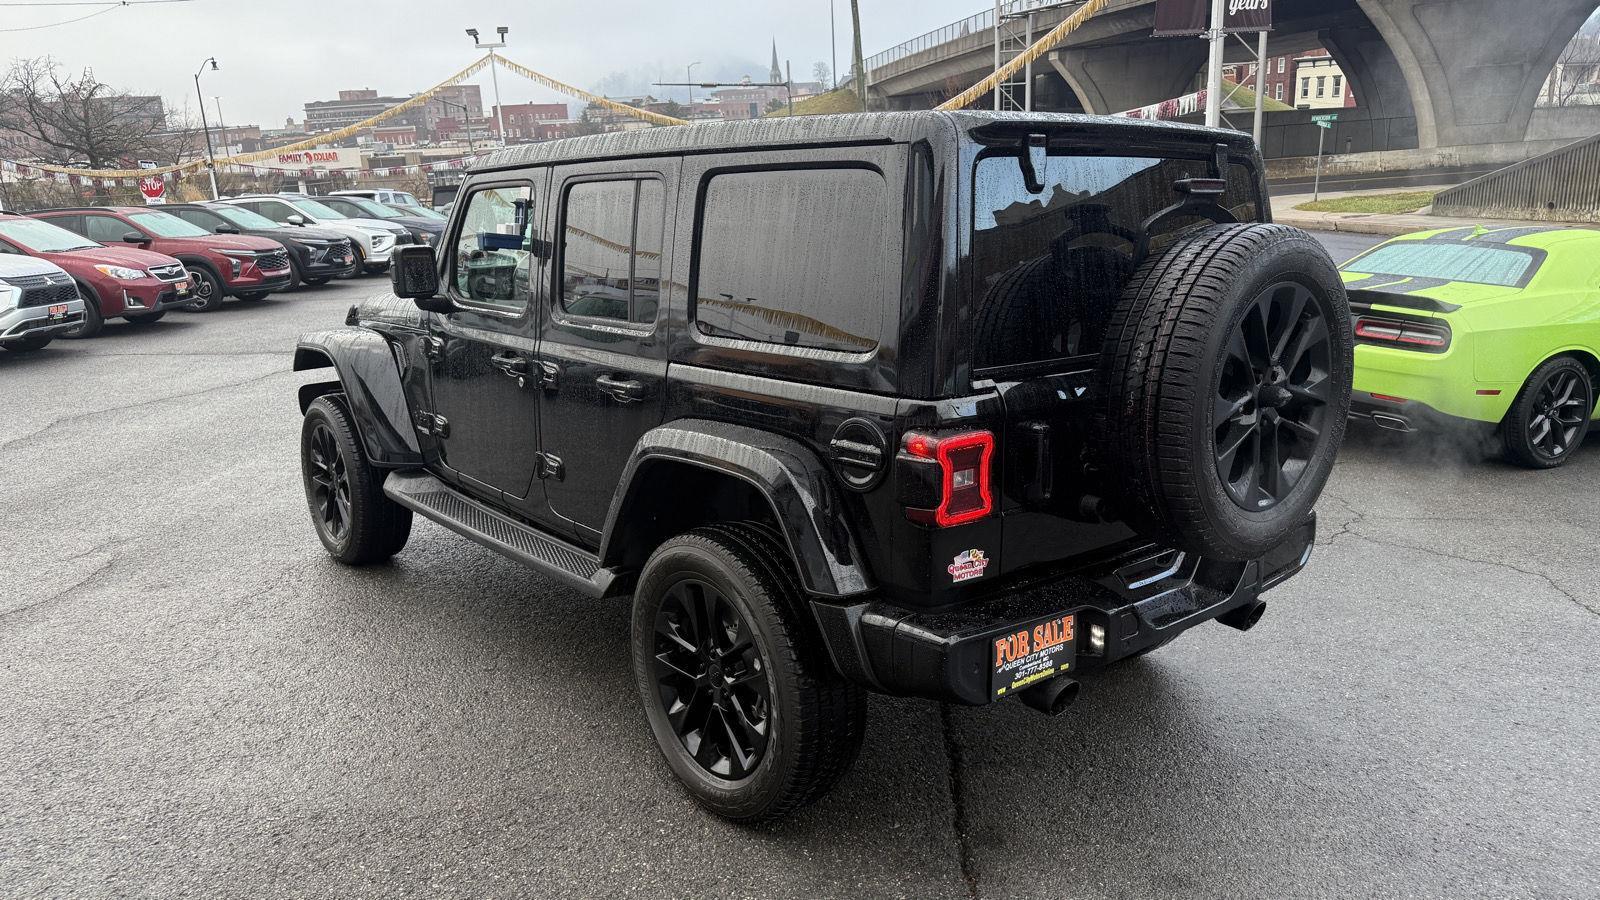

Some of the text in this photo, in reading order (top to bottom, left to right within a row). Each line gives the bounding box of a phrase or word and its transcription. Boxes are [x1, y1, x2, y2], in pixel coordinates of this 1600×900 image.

[1229, 0, 1268, 15] years
[279, 152, 339, 163] FAMILY DOLLAR
[141, 179, 162, 190] STOP
[949, 563, 972, 574] Queen
[954, 568, 983, 580] MOTORS
[995, 615, 1074, 667] FOR SALE
[1004, 644, 1064, 671] QUEEN CITY MOTORS
